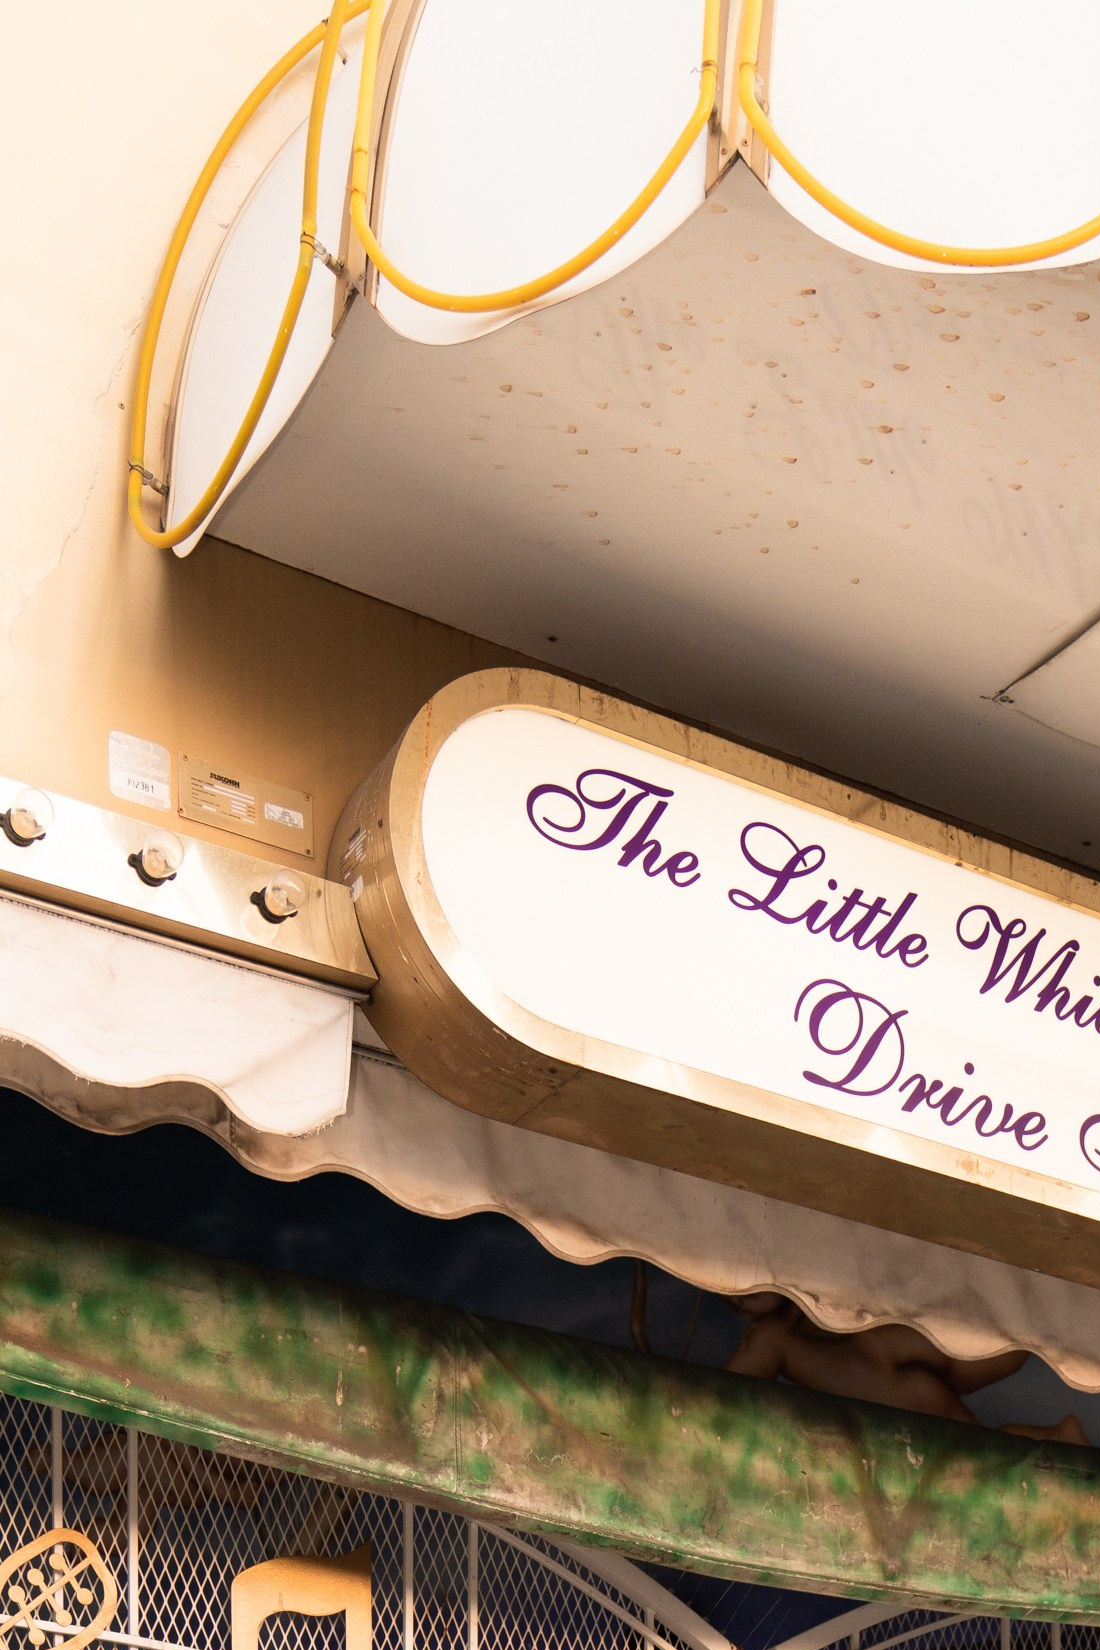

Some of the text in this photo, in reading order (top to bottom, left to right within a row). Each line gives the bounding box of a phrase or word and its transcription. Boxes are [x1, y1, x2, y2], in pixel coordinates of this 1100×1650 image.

[525, 768, 702, 889] The
[727, 821, 930, 969] Little
[793, 978, 1049, 1152] Drive
